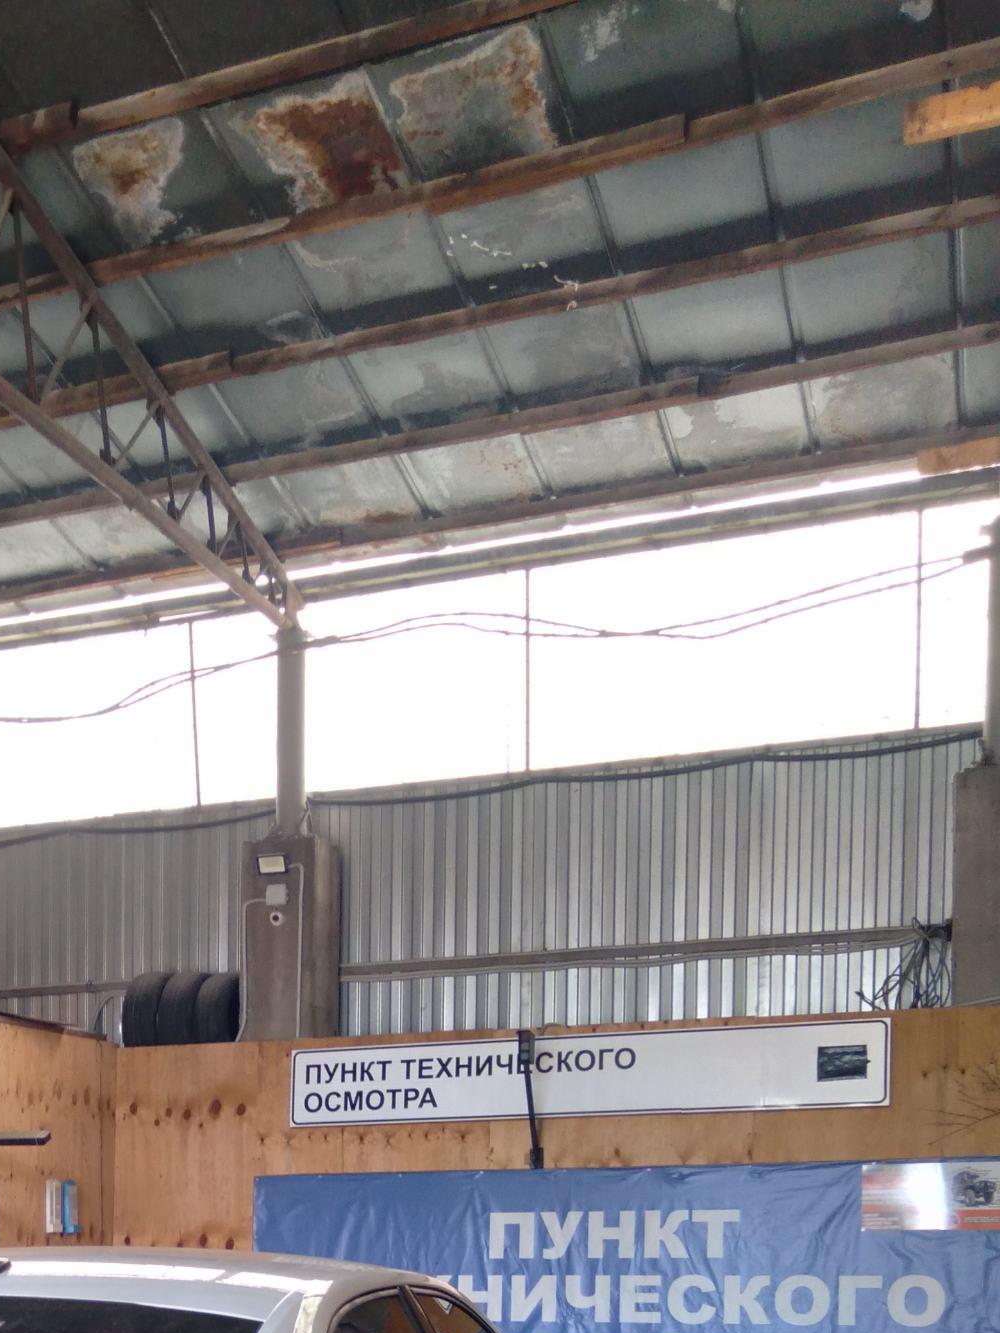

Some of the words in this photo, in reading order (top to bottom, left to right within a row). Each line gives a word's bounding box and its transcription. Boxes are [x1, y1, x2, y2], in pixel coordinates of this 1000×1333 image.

[304, 1060, 393, 1085] ПУНКТ
[303, 1087, 438, 1113] ОСМОТРА
[488, 1208, 741, 1260] ПУНКТ
[436, 1274, 947, 1327] НИЧЕСКОГО
